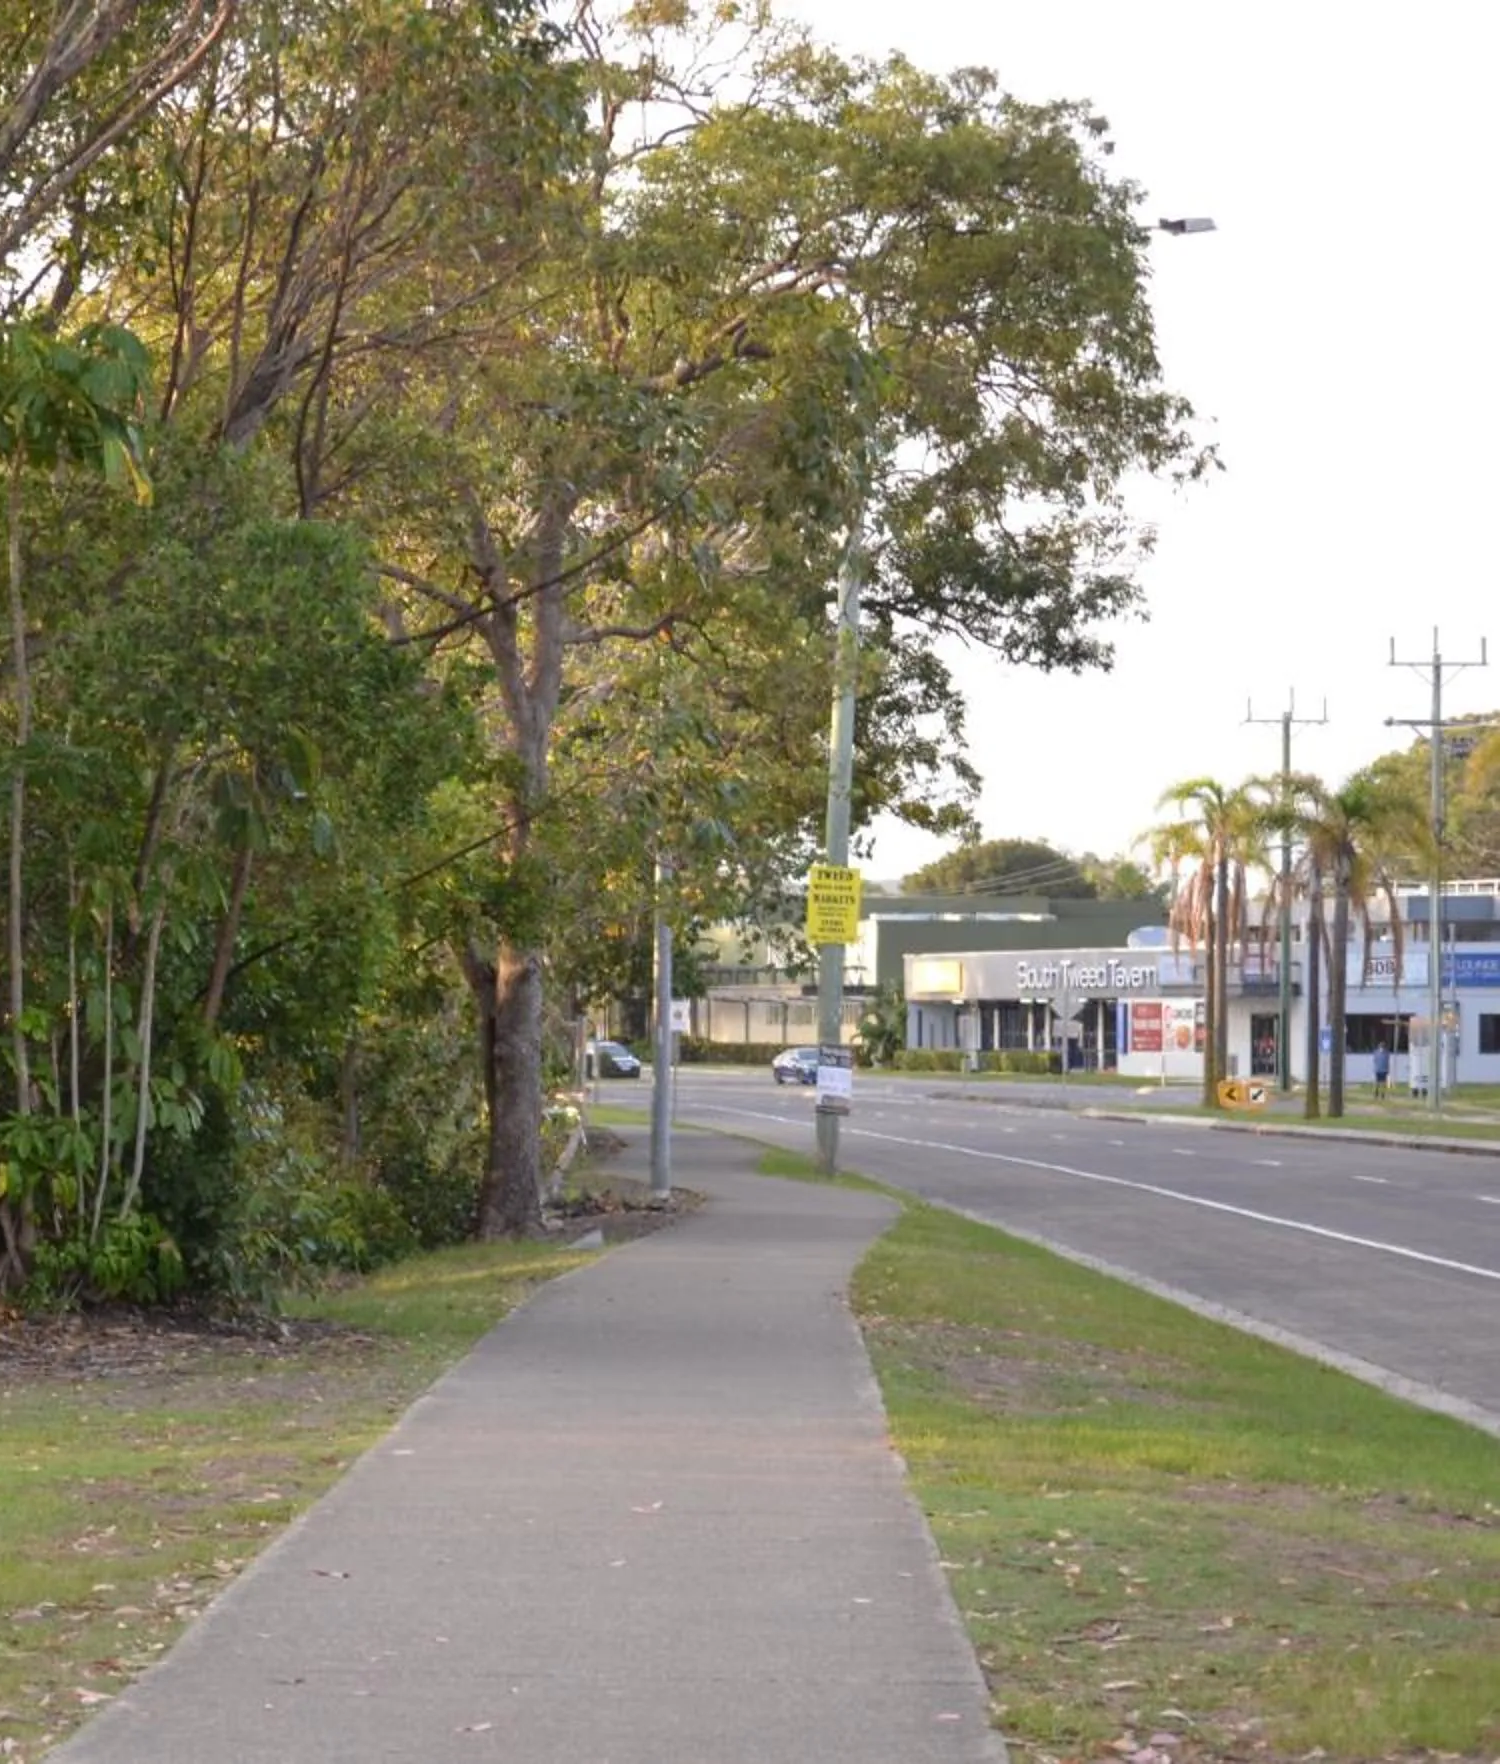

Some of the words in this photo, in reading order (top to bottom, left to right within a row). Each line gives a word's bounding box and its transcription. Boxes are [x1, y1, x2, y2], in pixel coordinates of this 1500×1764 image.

[813, 893, 856, 905] MARKETS
[1017, 961, 1058, 988] South
[1060, 960, 1106, 987] Tweed
[1108, 959, 1157, 987] Tavern
